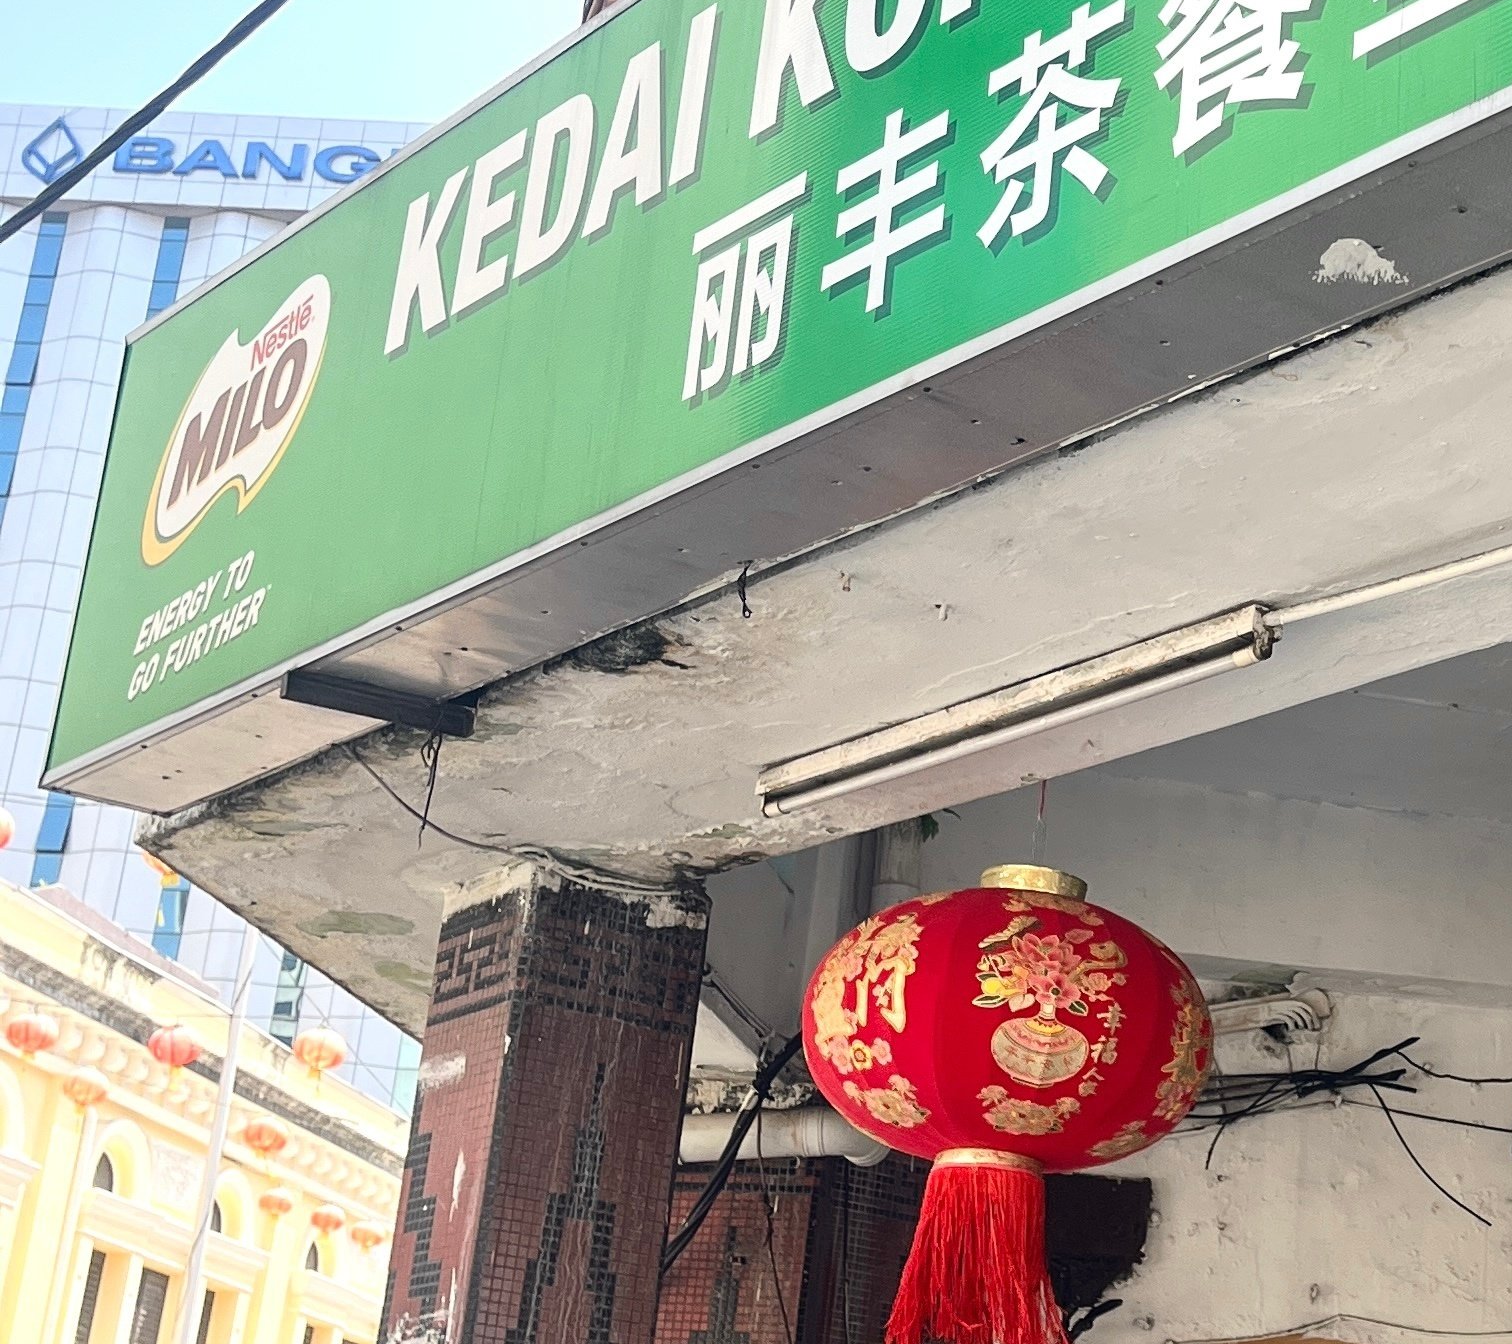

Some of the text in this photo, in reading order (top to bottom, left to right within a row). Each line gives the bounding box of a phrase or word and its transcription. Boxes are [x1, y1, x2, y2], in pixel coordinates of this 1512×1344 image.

[113, 136, 390, 184] BANG
[385, 3, 722, 358] KEDAI
[167, 338, 307, 511] MILO
[127, 587, 270, 702] GO FURTHER
[133, 550, 255, 657] ENERGY TO
